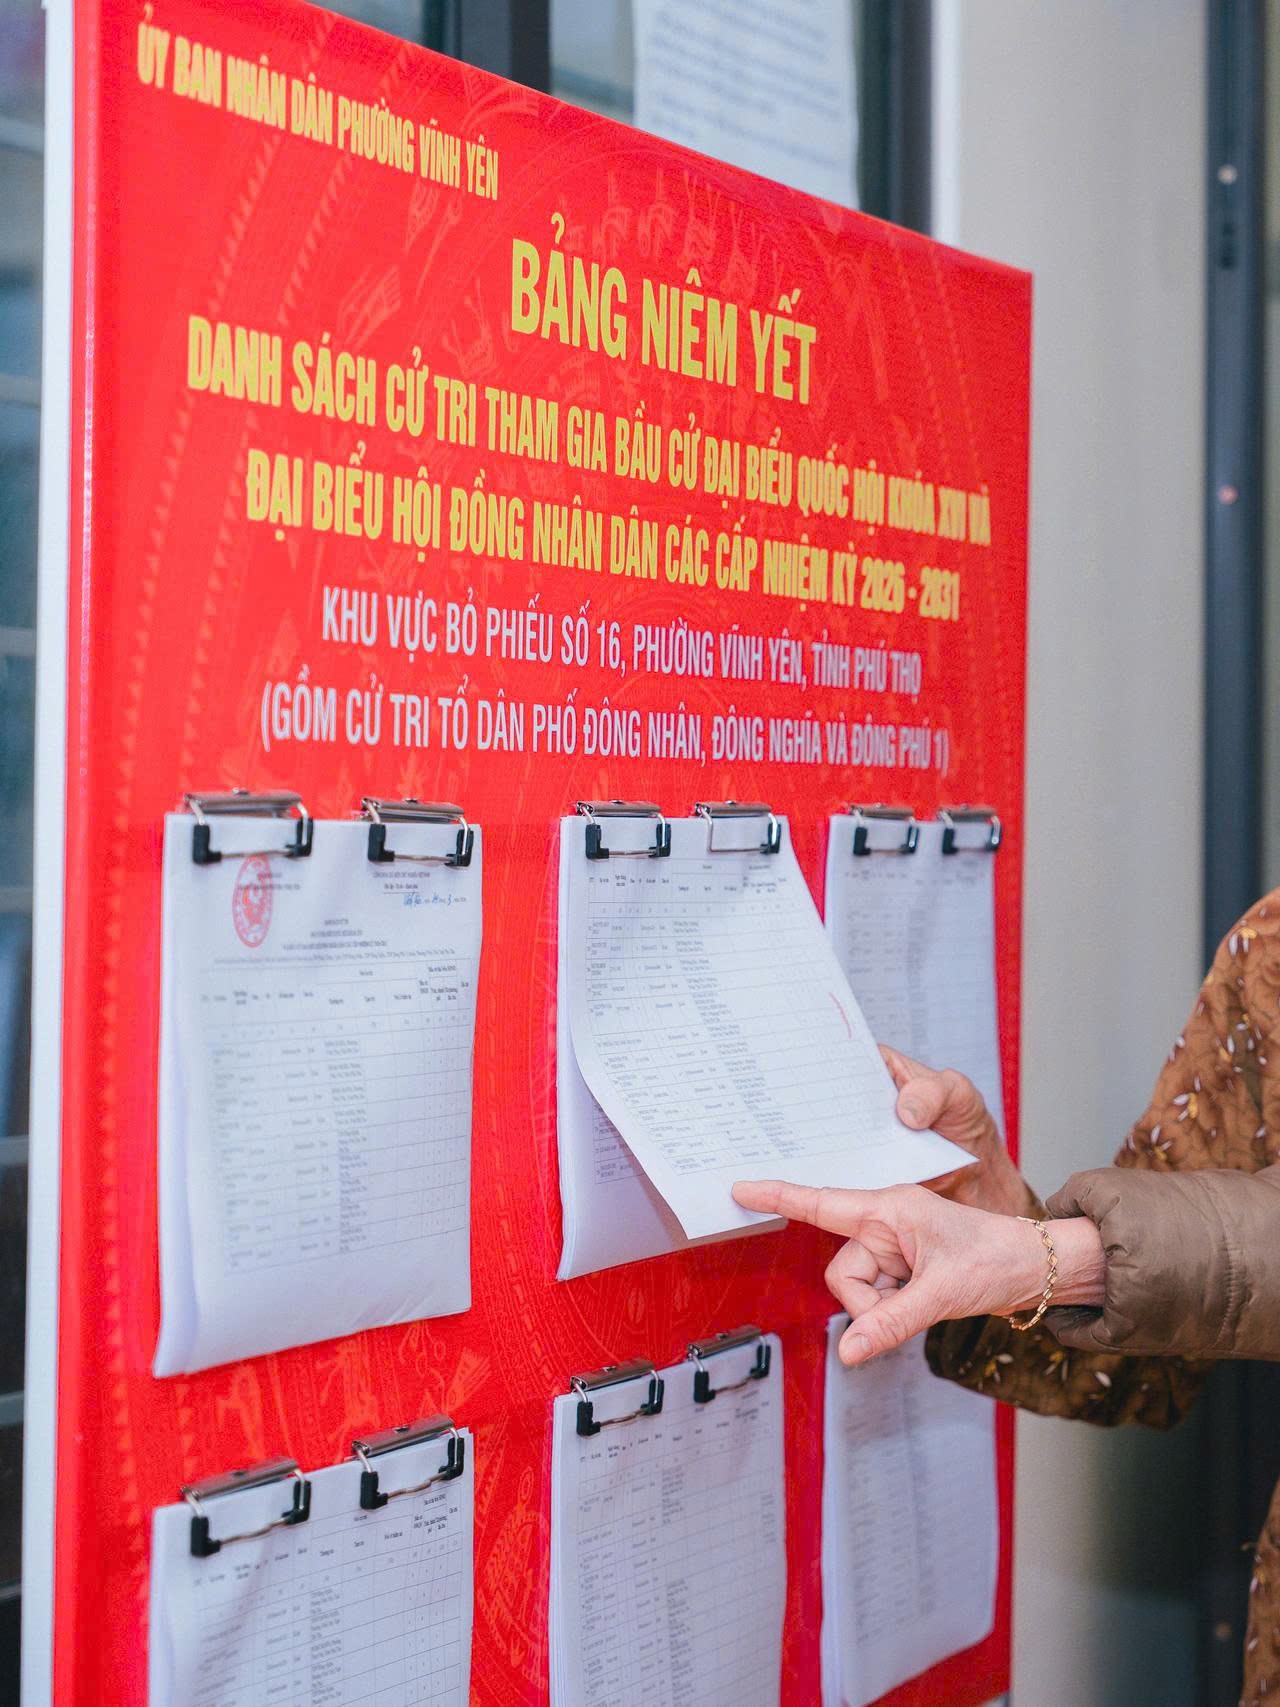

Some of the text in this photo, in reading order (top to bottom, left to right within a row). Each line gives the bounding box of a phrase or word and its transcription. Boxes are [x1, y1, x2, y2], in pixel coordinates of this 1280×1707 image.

[138, 3, 498, 200] ỦY BAN NHÂN DÂN PHƯỜNG VĨNH YÊN
[511, 212, 816, 404] BẢNG NIÊM YẾT
[187, 314, 281, 406] DANH
[292, 332, 376, 426] SÁCH
[386, 346, 428, 436] CỬ
[434, 375, 476, 446] TRI
[485, 387, 558, 463] THAM
[567, 405, 607, 473] GIA
[615, 400, 661, 483] BẦU
[669, 412, 700, 490] CỬ
[704, 435, 739, 508] ĐẠI
[746, 427, 792, 507] BIỂU
[798, 443, 849, 518] QUỐC
[853, 459, 885, 536] HỘI
[969, 484, 990, 547] VÀ
[246, 449, 302, 541] ĐẠI
[313, 441, 383, 539] BIỂU
[393, 466, 441, 562] HỘI
[450, 469, 524, 561] ĐỒNG
[533, 495, 602, 572] NHÂN
[610, 505, 658, 580] DÂN
[665, 514, 709, 587] CÁC
[716, 515, 758, 592] CẤP
[763, 533, 828, 612] NHIỆM
[832, 541, 858, 607] KỲ
[860, 556, 905, 614] 2026
[322, 586, 378, 647] KHU
[387, 590, 437, 663] VỰC
[446, 587, 477, 656] BỎ
[486, 593, 553, 663] PHIẾU
[561, 600, 590, 667] SỐ
[597, 620, 626, 678] 16,
[633, 616, 714, 678] PHƯỜNG
[719, 624, 763, 681] VĨNH
[768, 628, 807, 692] YÊN,
[853, 640, 888, 693] PHÚ
[890, 650, 921, 704] THỌ
[346, 673, 383, 745] CỬ
[389, 693, 429, 748] TRI
[438, 674, 469, 750] TỔ
[477, 689, 524, 752] DÂN
[533, 688, 579, 755] PHỐ
[583, 696, 641, 757] ĐÔNG
[648, 701, 707, 767] NHÂN,
[712, 705, 764, 761] ĐÔNG
[826, 711, 849, 765] VÀ
[851, 713, 896, 768] ĐÔNG
[900, 717, 931, 770] PHÚ
[934, 727, 949, 779] 1)
